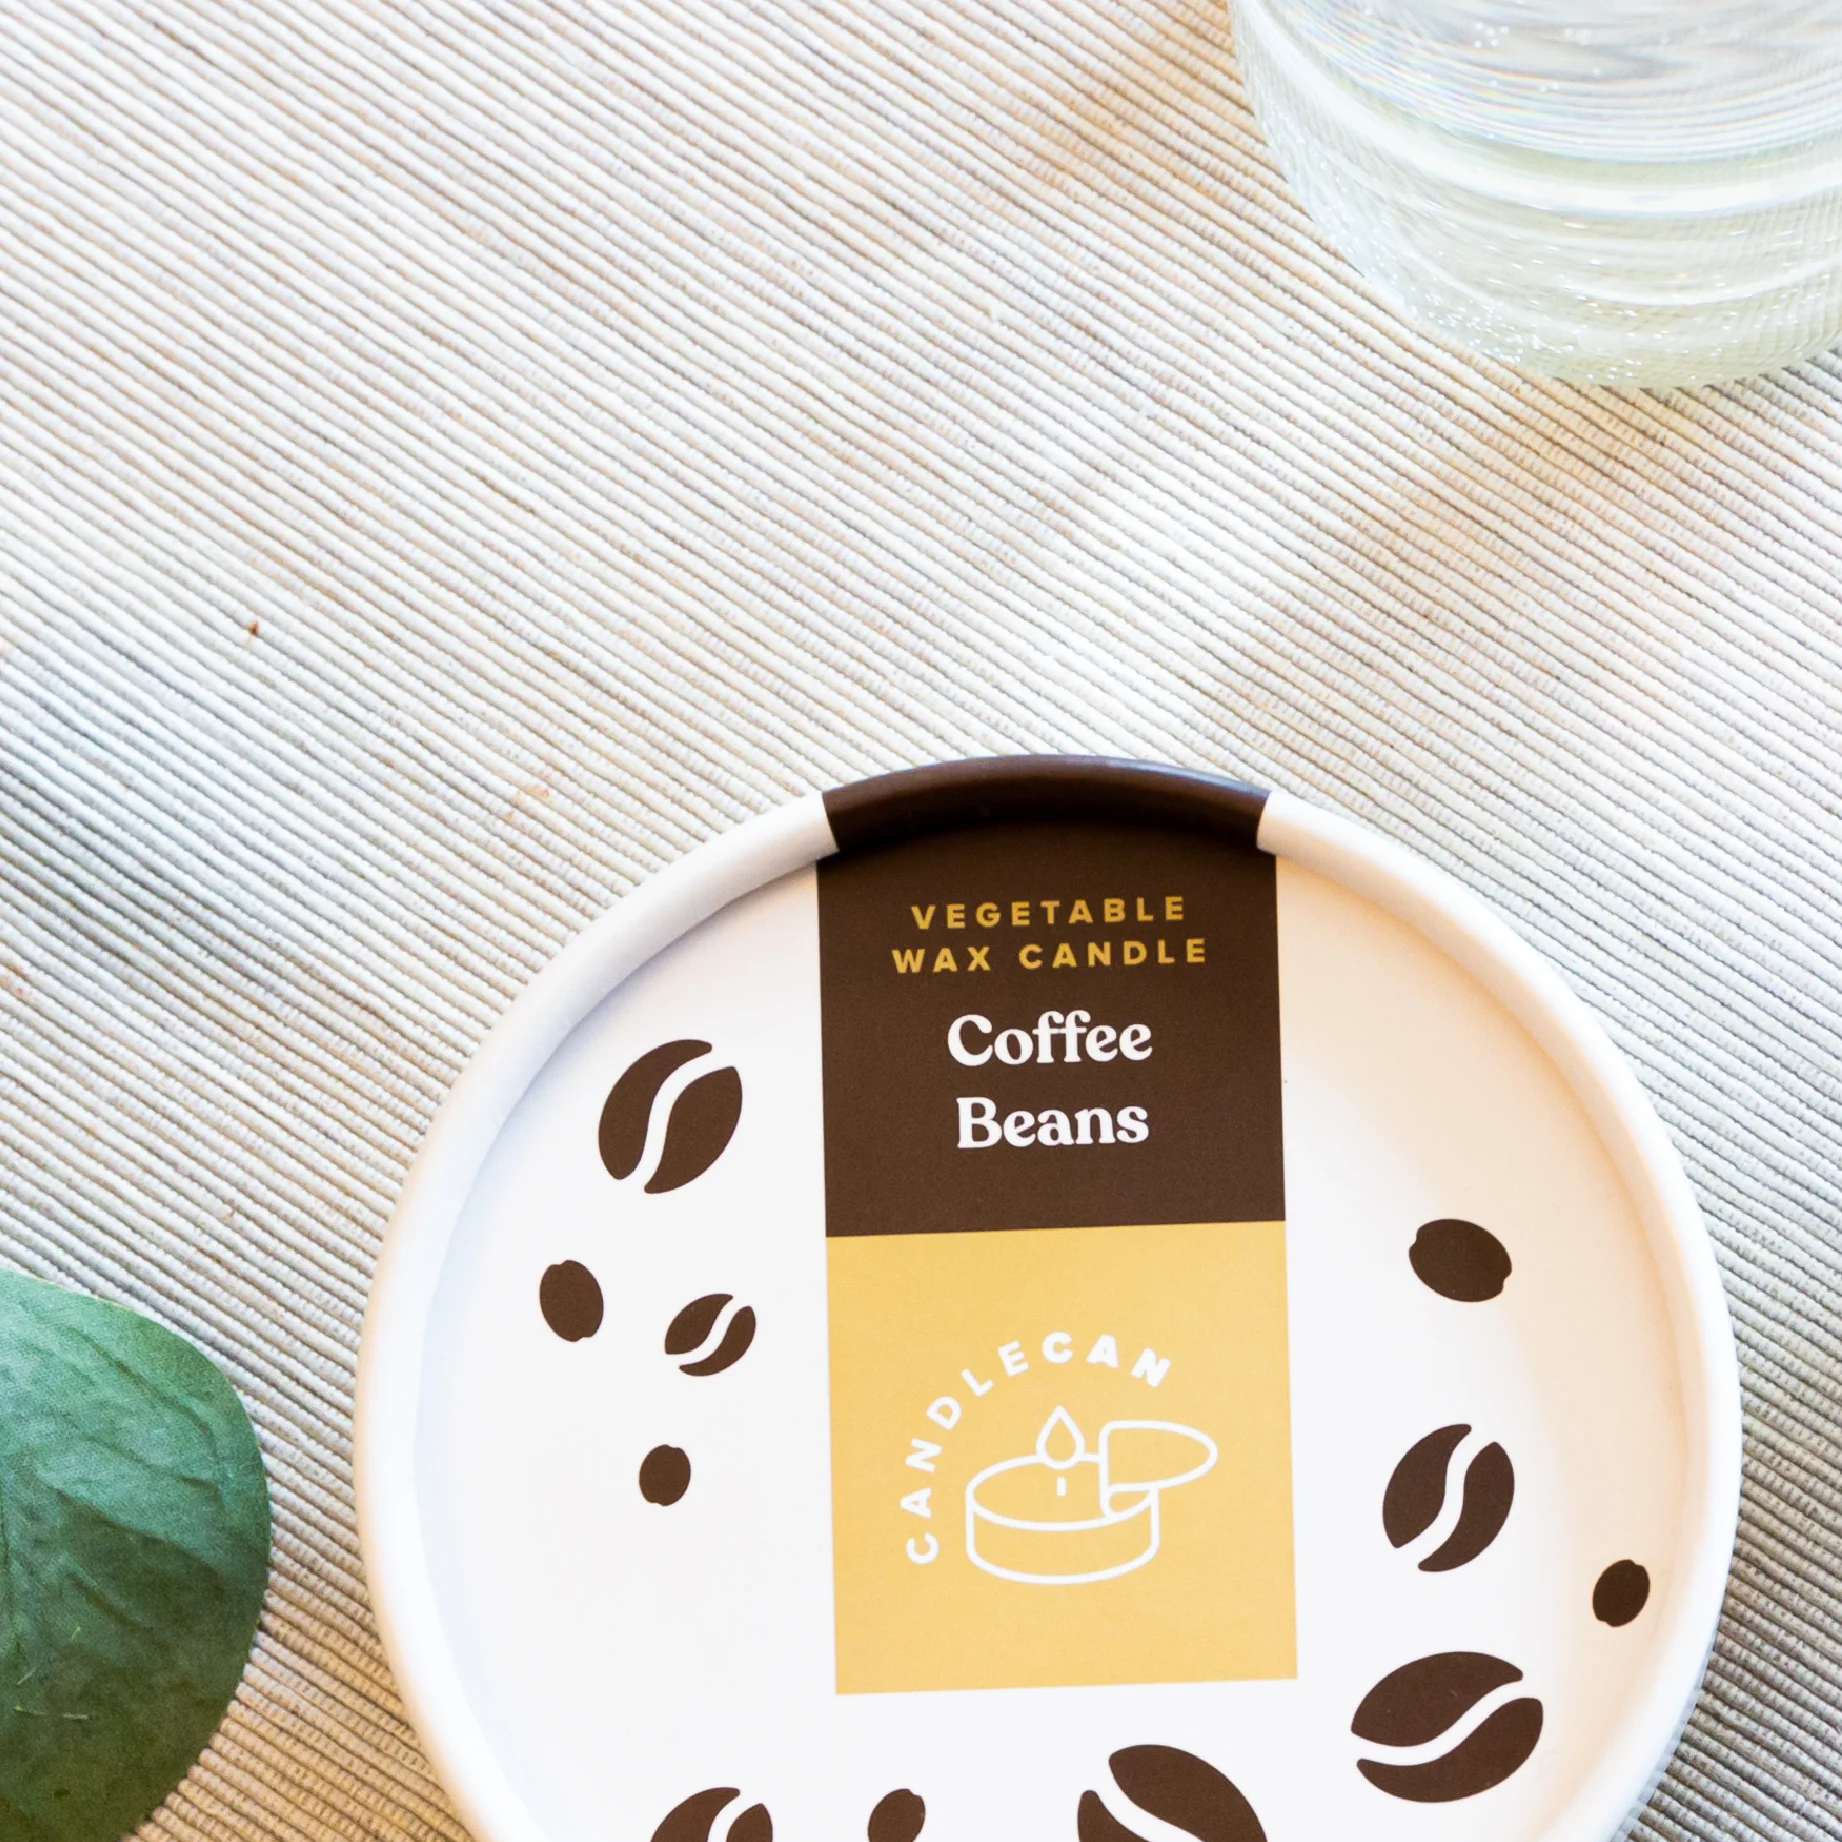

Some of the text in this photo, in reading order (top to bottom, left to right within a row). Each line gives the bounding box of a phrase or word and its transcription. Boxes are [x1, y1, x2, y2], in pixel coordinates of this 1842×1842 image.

[911, 896, 1185, 930] VEGETABLE
[892, 938, 1206, 974] WAX CANDLE
[947, 1009, 1153, 1067] Coffee
[956, 1096, 1150, 1149] Beans
[900, 1331, 1171, 1565] CANDLECAN
